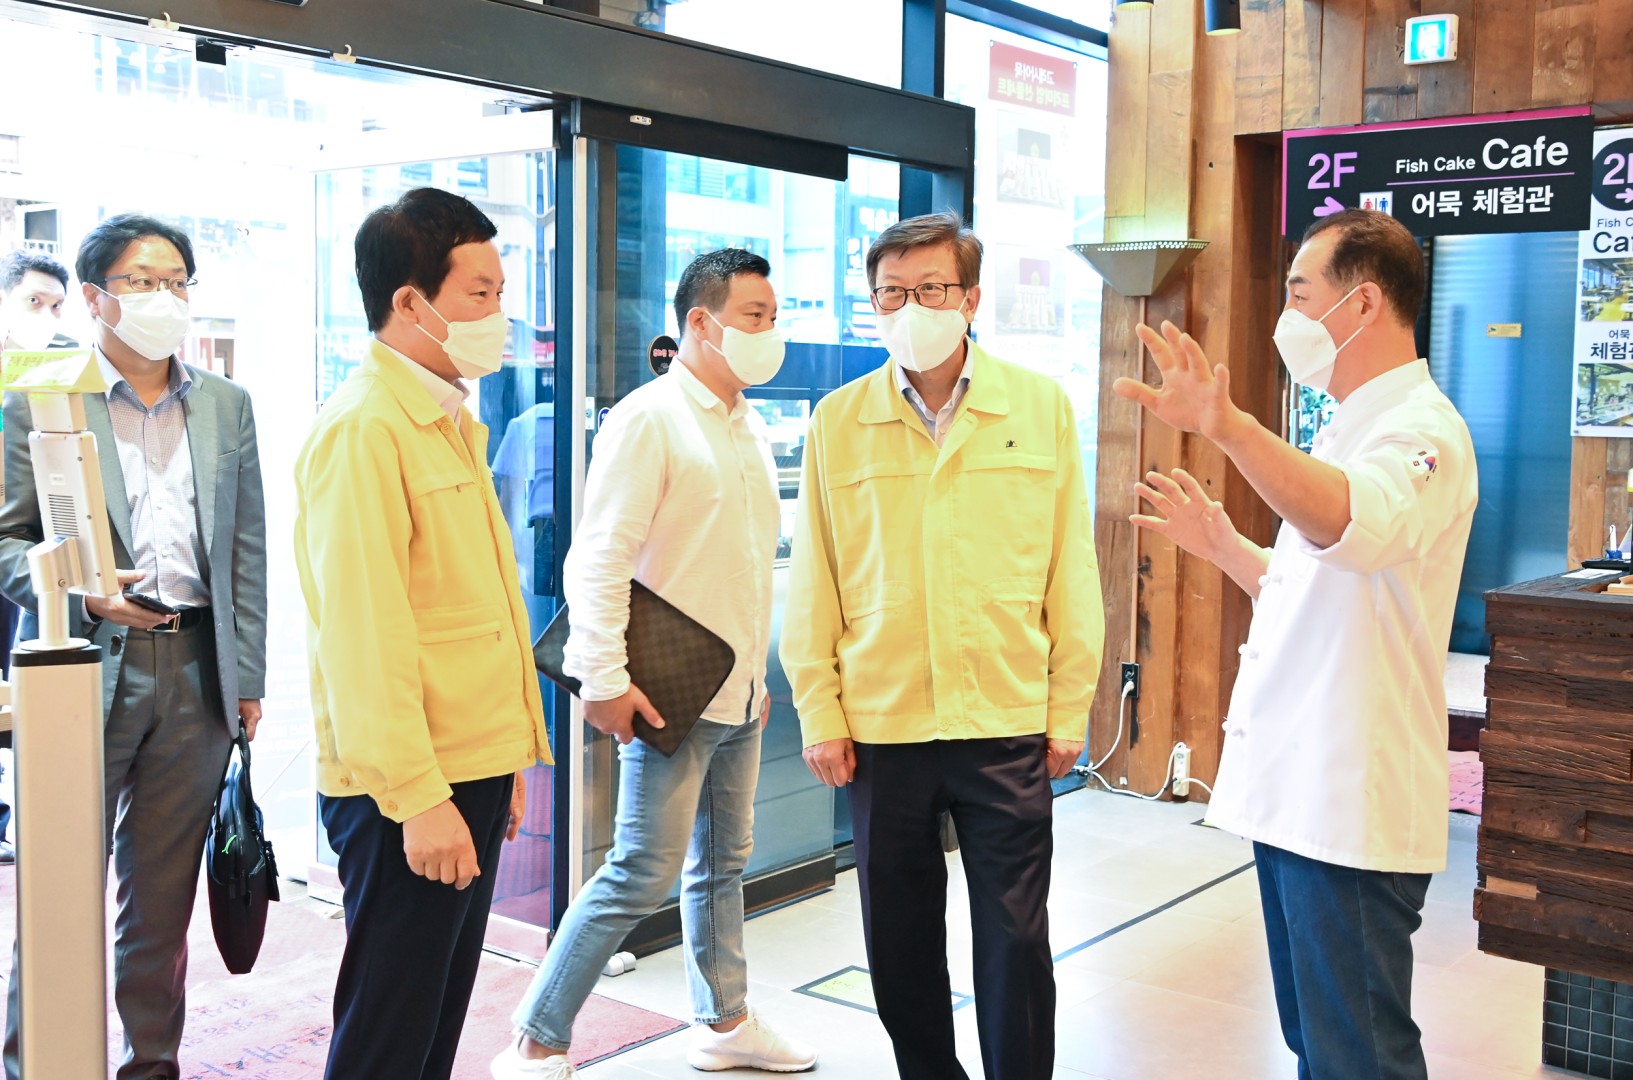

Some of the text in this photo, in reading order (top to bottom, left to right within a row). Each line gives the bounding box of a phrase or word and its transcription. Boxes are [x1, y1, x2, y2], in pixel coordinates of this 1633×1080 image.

[1395, 135, 1569, 174] Fish Cake Cafe
[1307, 151, 1358, 189] 2F
[1411, 185, 1554, 218] 어묵 체험관
[1597, 218, 1621, 228] Fish
[1593, 231, 1633, 253] Ca
[1608, 329, 1630, 340] 어묵
